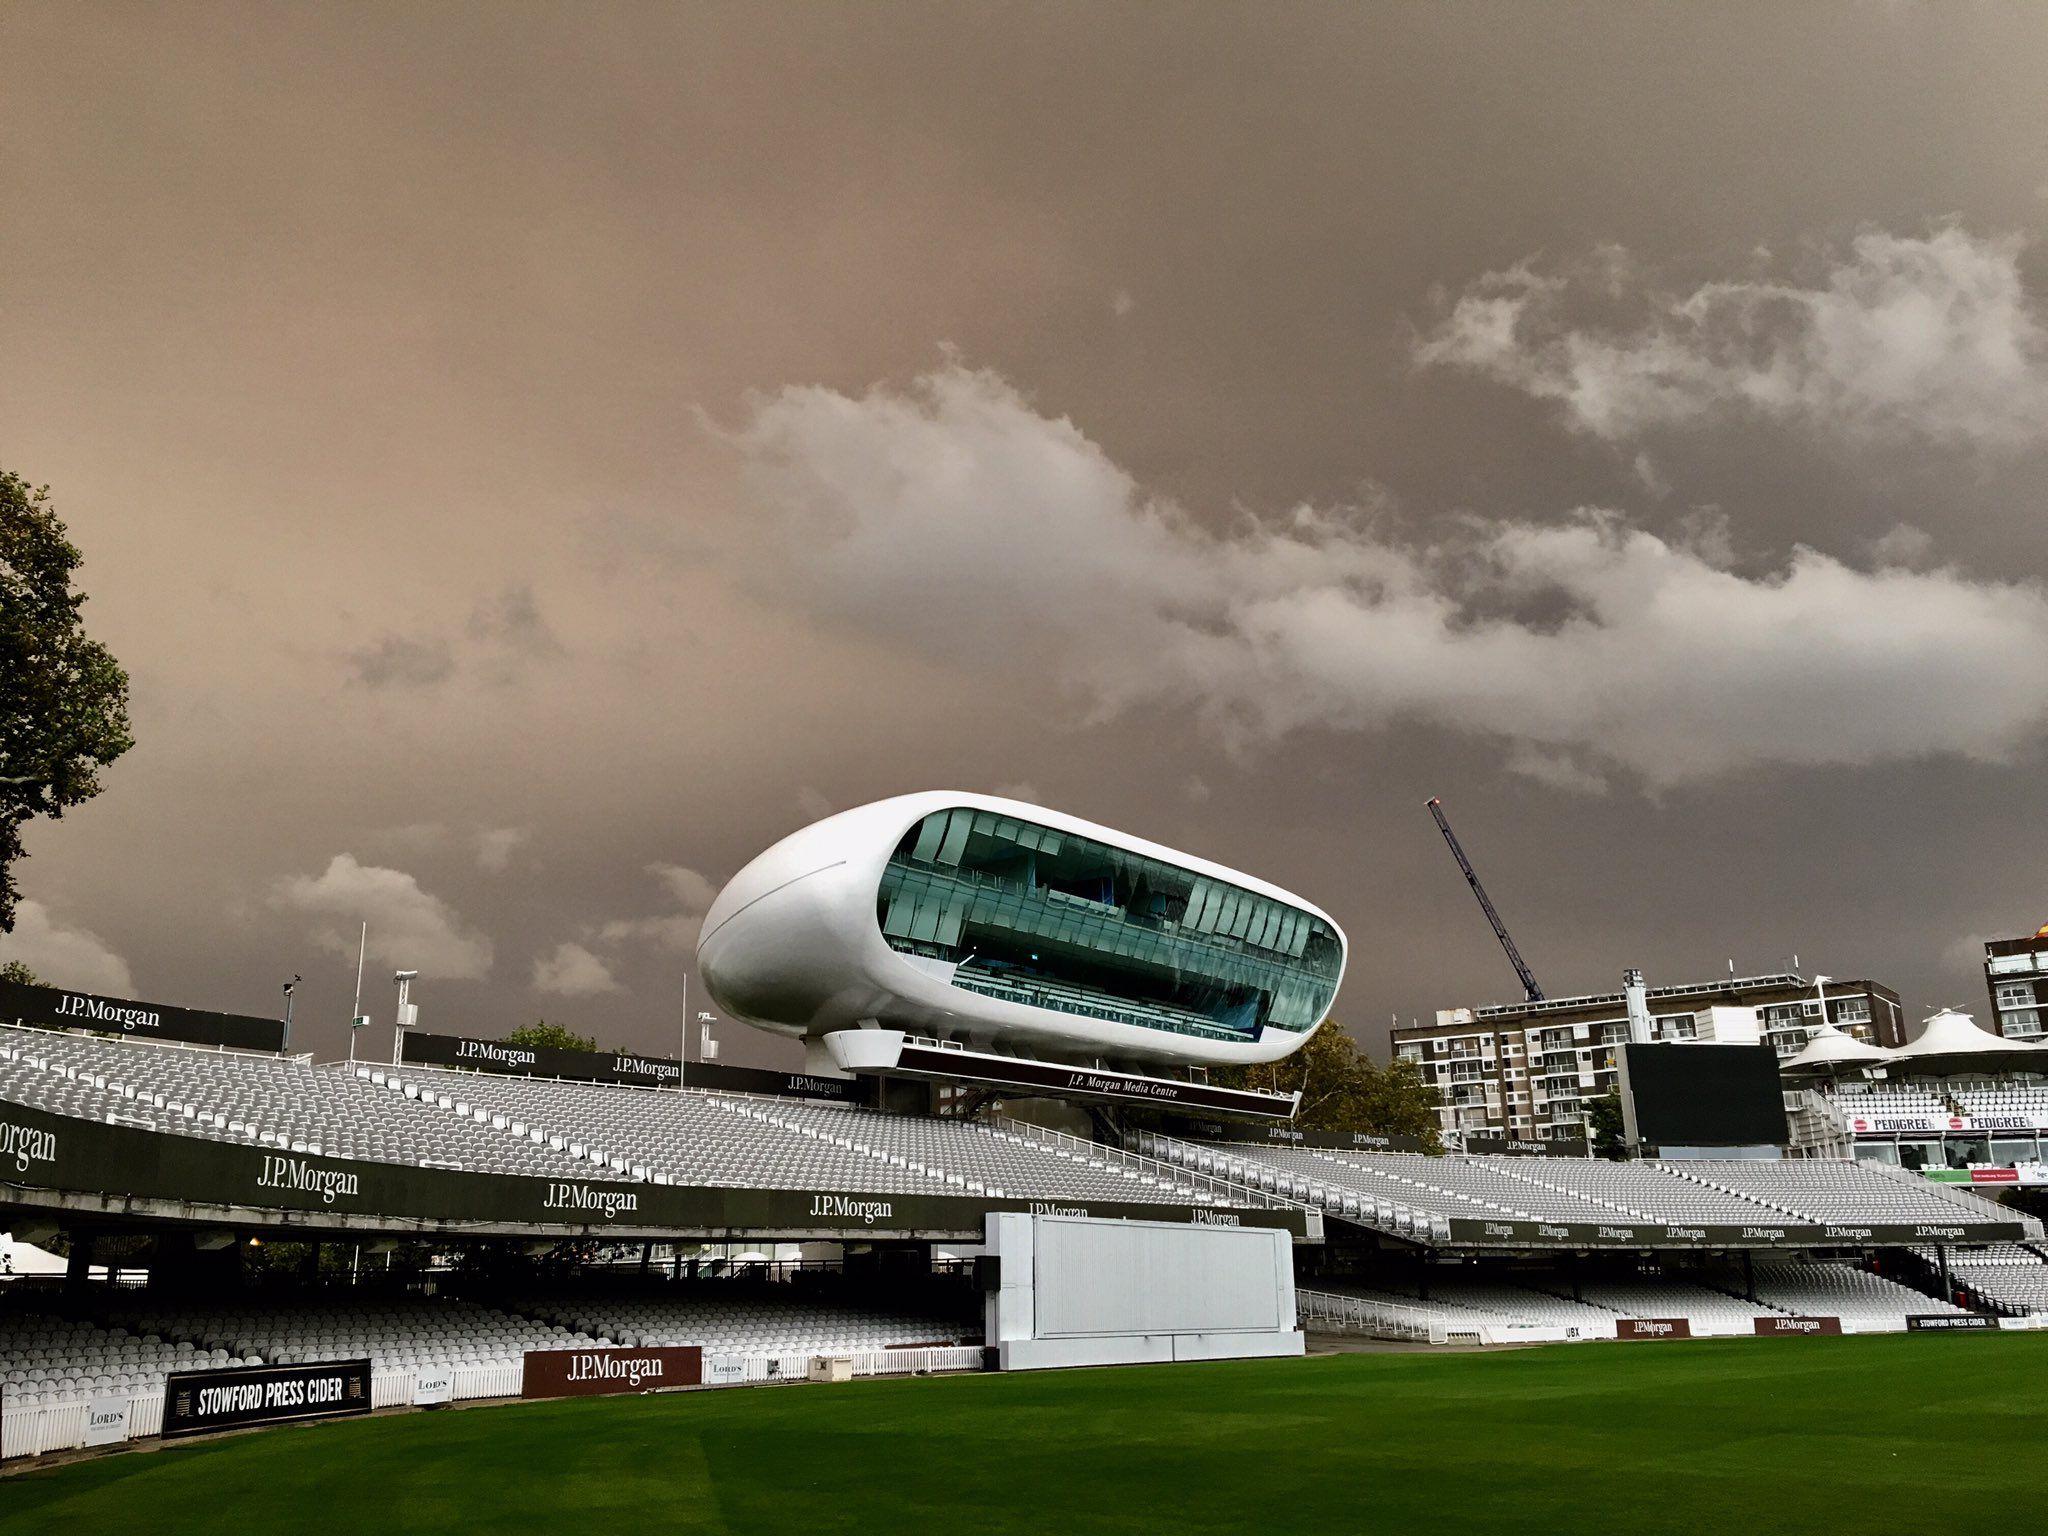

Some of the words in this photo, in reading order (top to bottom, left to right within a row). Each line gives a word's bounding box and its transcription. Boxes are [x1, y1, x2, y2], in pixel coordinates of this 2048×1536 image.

[55, 994, 160, 1029] J.P.Morgan
[456, 1041, 536, 1066] J.P.Morgan
[613, 1056, 679, 1081] J.P.Morgan
[788, 1076, 842, 1097] J.P.Morgan
[1086, 1076, 1121, 1093] Morgan
[1122, 1081, 1148, 1094] Media
[1150, 1084, 1178, 1098] Centre
[1874, 1118, 1928, 1130] PEDIGREE
[1970, 1116, 2026, 1128] PEDIGREE
[1353, 1133, 1390, 1147] J.P.Morgan
[1506, 1140, 1547, 1153] J.P.Morgan
[257, 1155, 359, 1204] J.P.Morgan
[544, 1182, 638, 1218] J.P.Morgan
[810, 1194, 892, 1224] J.P.Morgan
[1029, 1203, 1088, 1217] JPMorgan
[1484, 1223, 1514, 1239] J.P.Morgan
[1538, 1224, 1569, 1240] J.P.Morgan
[1598, 1226, 1634, 1241] J.P.Morgan
[1665, 1227, 1706, 1241] J.P.Morgan
[1742, 1227, 1786, 1241] J.P.Morgan
[1825, 1226, 1872, 1240] J.P.Morgan
[1915, 1225, 1965, 1239] J.P.Morgan
[1774, 1319, 1821, 1333] J.P.Morgan
[566, 1354, 663, 1386] J.P.Morgan
[197, 1383, 263, 1416] STOWFORD
[265, 1380, 304, 1408] PRESS
[307, 1377, 343, 1403] CIDER
